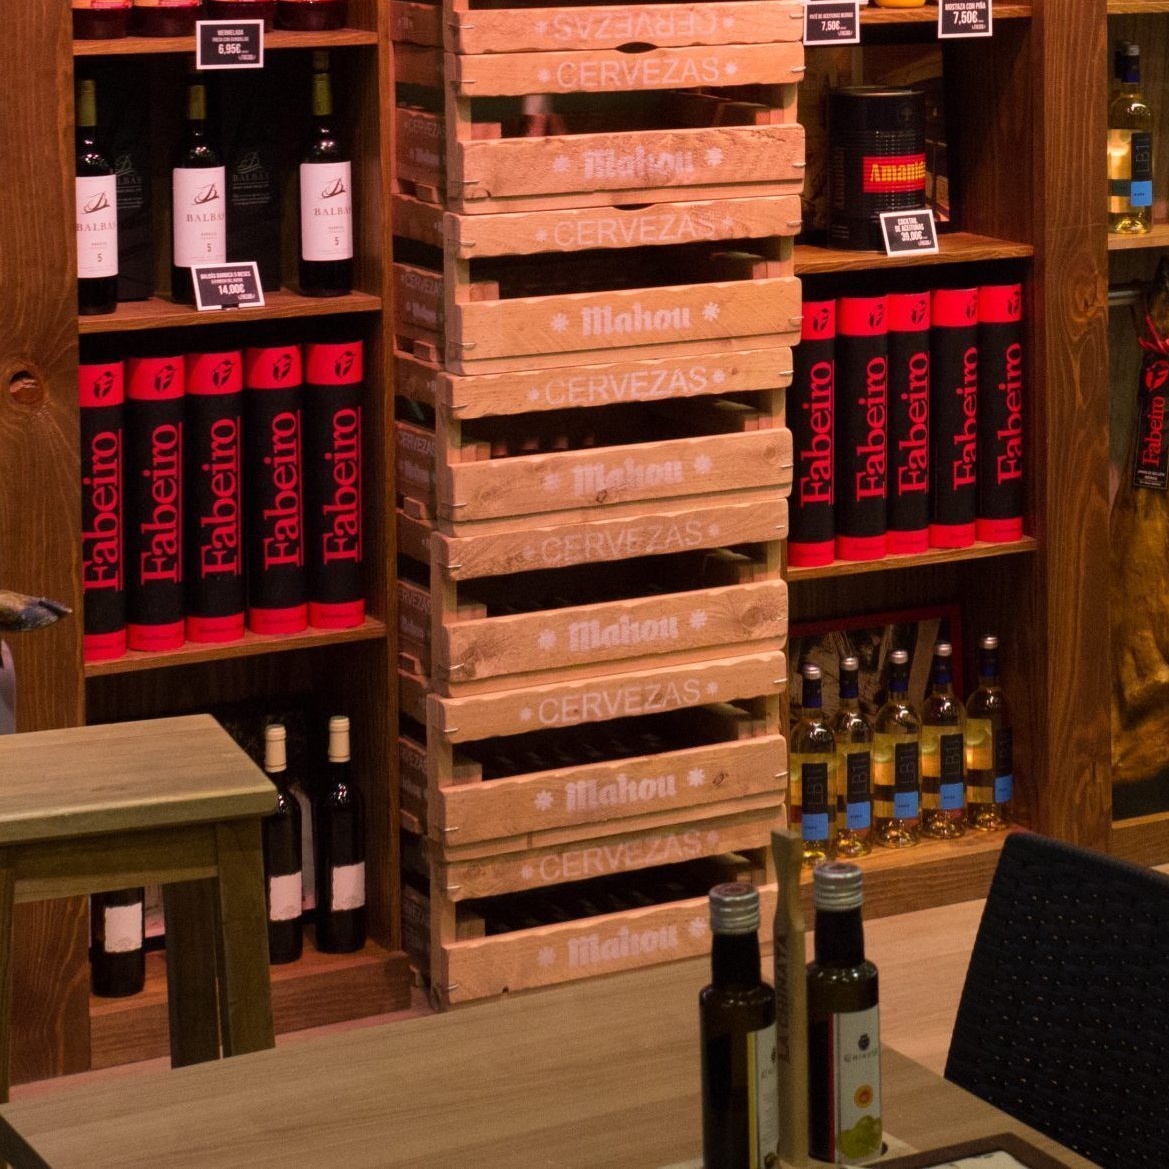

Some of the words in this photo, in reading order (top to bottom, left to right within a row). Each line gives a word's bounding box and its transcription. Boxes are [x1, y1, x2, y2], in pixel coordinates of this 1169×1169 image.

[821, 19, 841, 32] 7,50€
[953, 10, 979, 25] 7,50€
[218, 43, 241, 55] 6,95€
[556, 56, 720, 89] CERVEZAS
[582, 145, 695, 180] Mahou
[555, 214, 717, 247] CERVEZAS
[218, 283, 246, 295] 14,00€
[581, 303, 692, 336] Mahou
[545, 365, 708, 407] CERVEZAS
[800, 360, 833, 508] Fabeiro
[856, 356, 887, 503] Fabeiro
[899, 351, 928, 496] Fabeiro
[954, 346, 978, 491] Fabeiro
[998, 342, 1023, 486] Fabeiro
[1142, 395, 1166, 467] Fabeiro
[201, 418, 238, 579] Fabeiro
[264, 411, 301, 571] Fabeiro
[323, 408, 359, 566] Fabeiro
[571, 456, 684, 497] Mahou
[82, 431, 120, 594] Fabeiro
[141, 423, 179, 586] Fabeiro
[541, 520, 704, 564] CERVEZAS
[567, 614, 680, 652] Mahou
[538, 678, 701, 724] CERVEZAS
[565, 773, 678, 813] Mahou
[538, 830, 702, 881] CERVEZAS
[567, 925, 680, 969] Mahou
